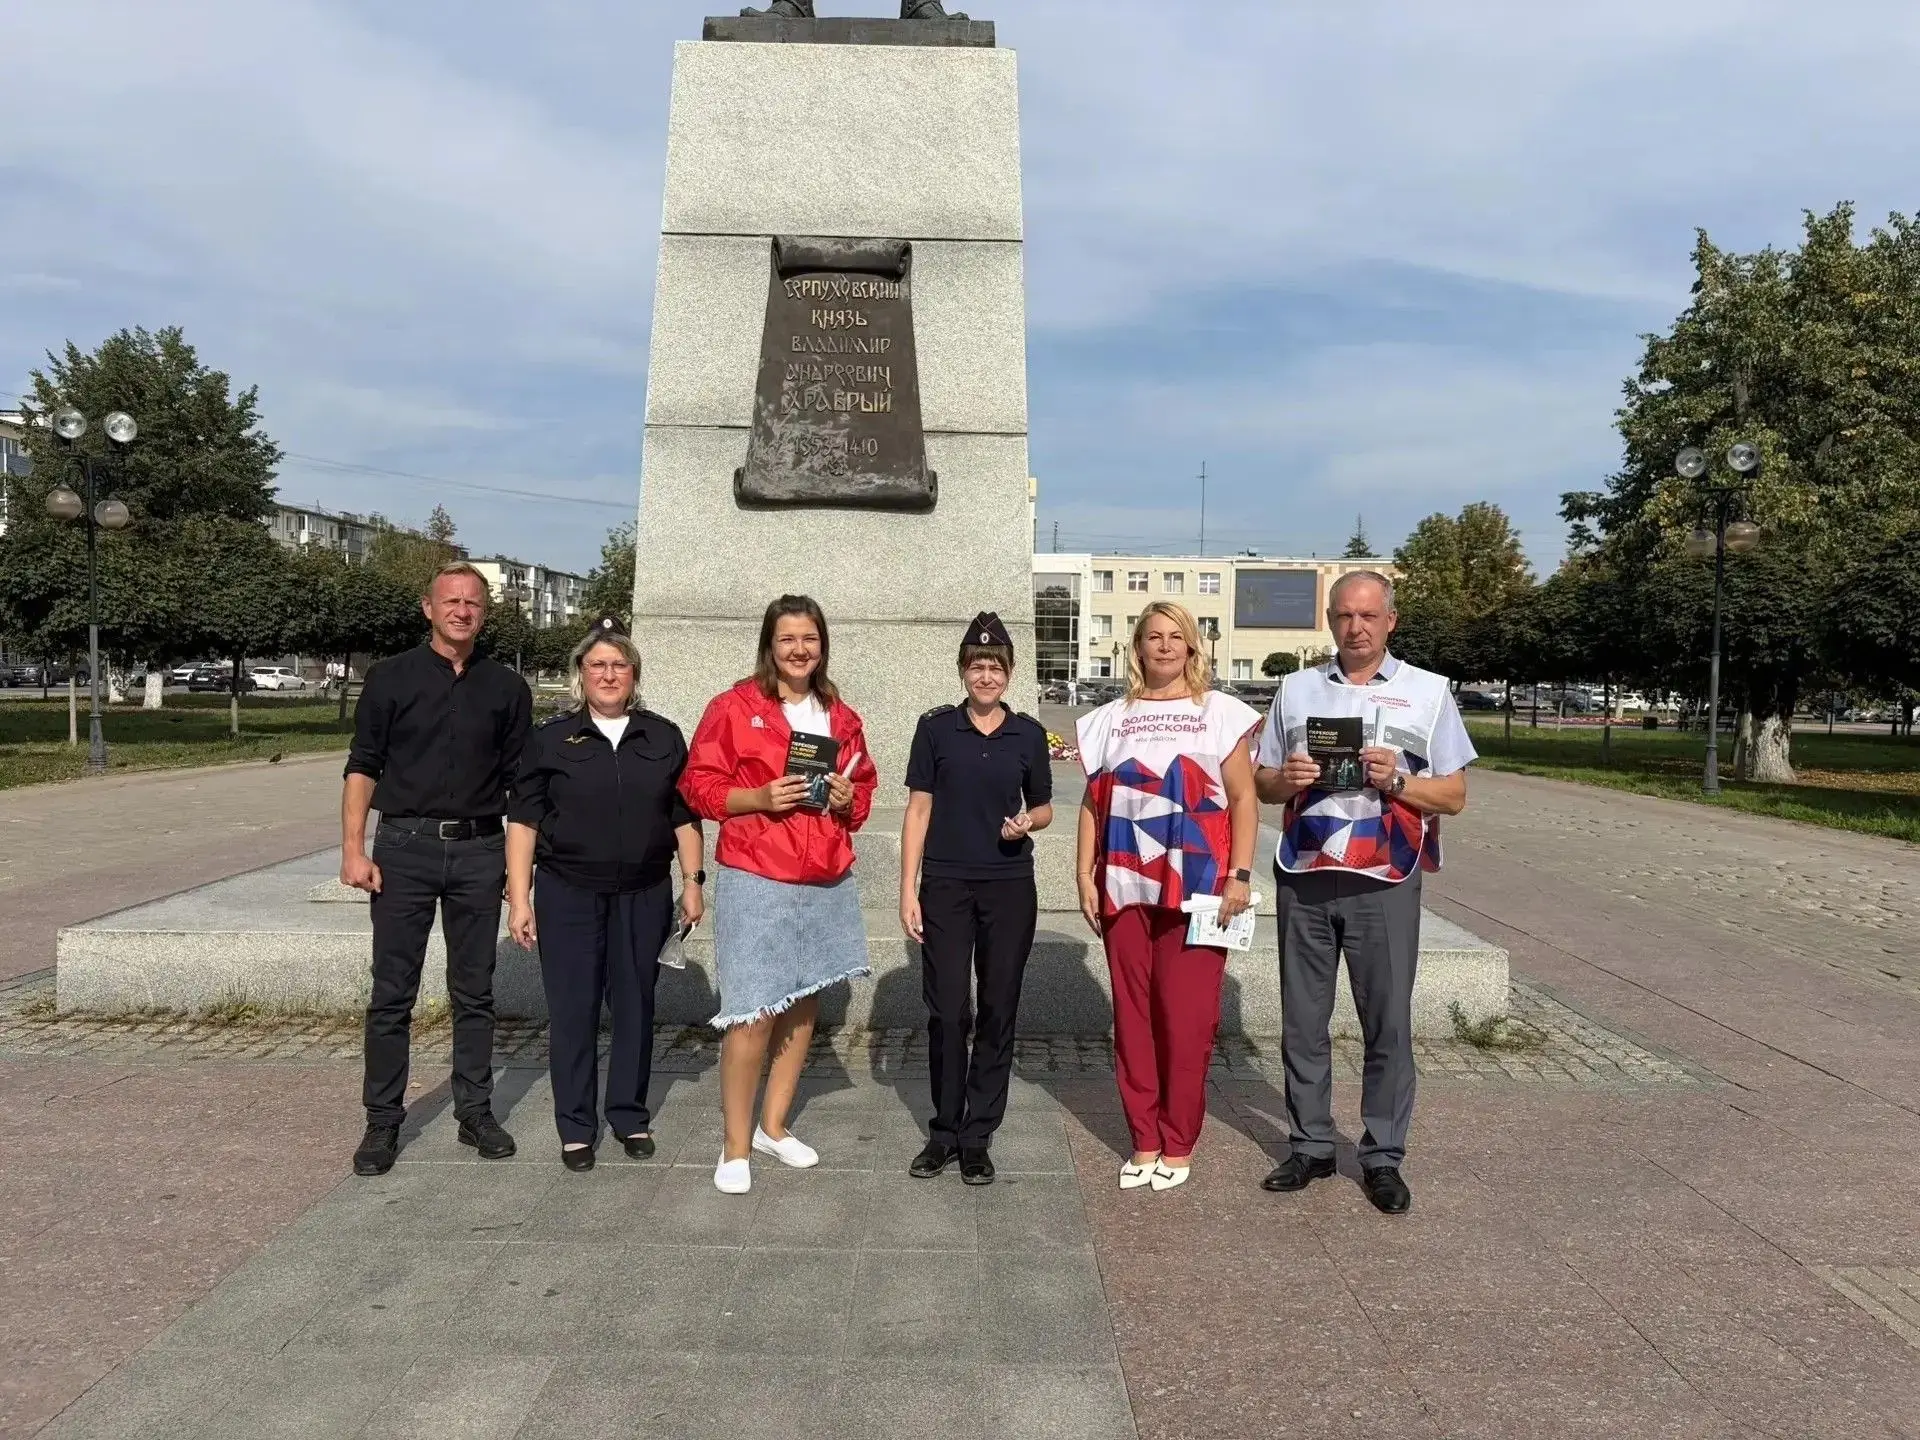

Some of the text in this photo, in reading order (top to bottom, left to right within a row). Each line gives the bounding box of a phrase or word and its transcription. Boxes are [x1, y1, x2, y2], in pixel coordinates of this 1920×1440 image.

[811, 309, 868, 330] КНЯЗЬ
[791, 335, 891, 354] ВЛАДИМИР
[785, 362, 893, 388] АНДРЕЕВИЧ
[781, 388, 892, 413] ХРАБРЫЙ
[1111, 723, 1207, 738] ПОДМОСКОВЬЯ
[1121, 714, 1202, 727] ВОЛОНТЕРЫ
